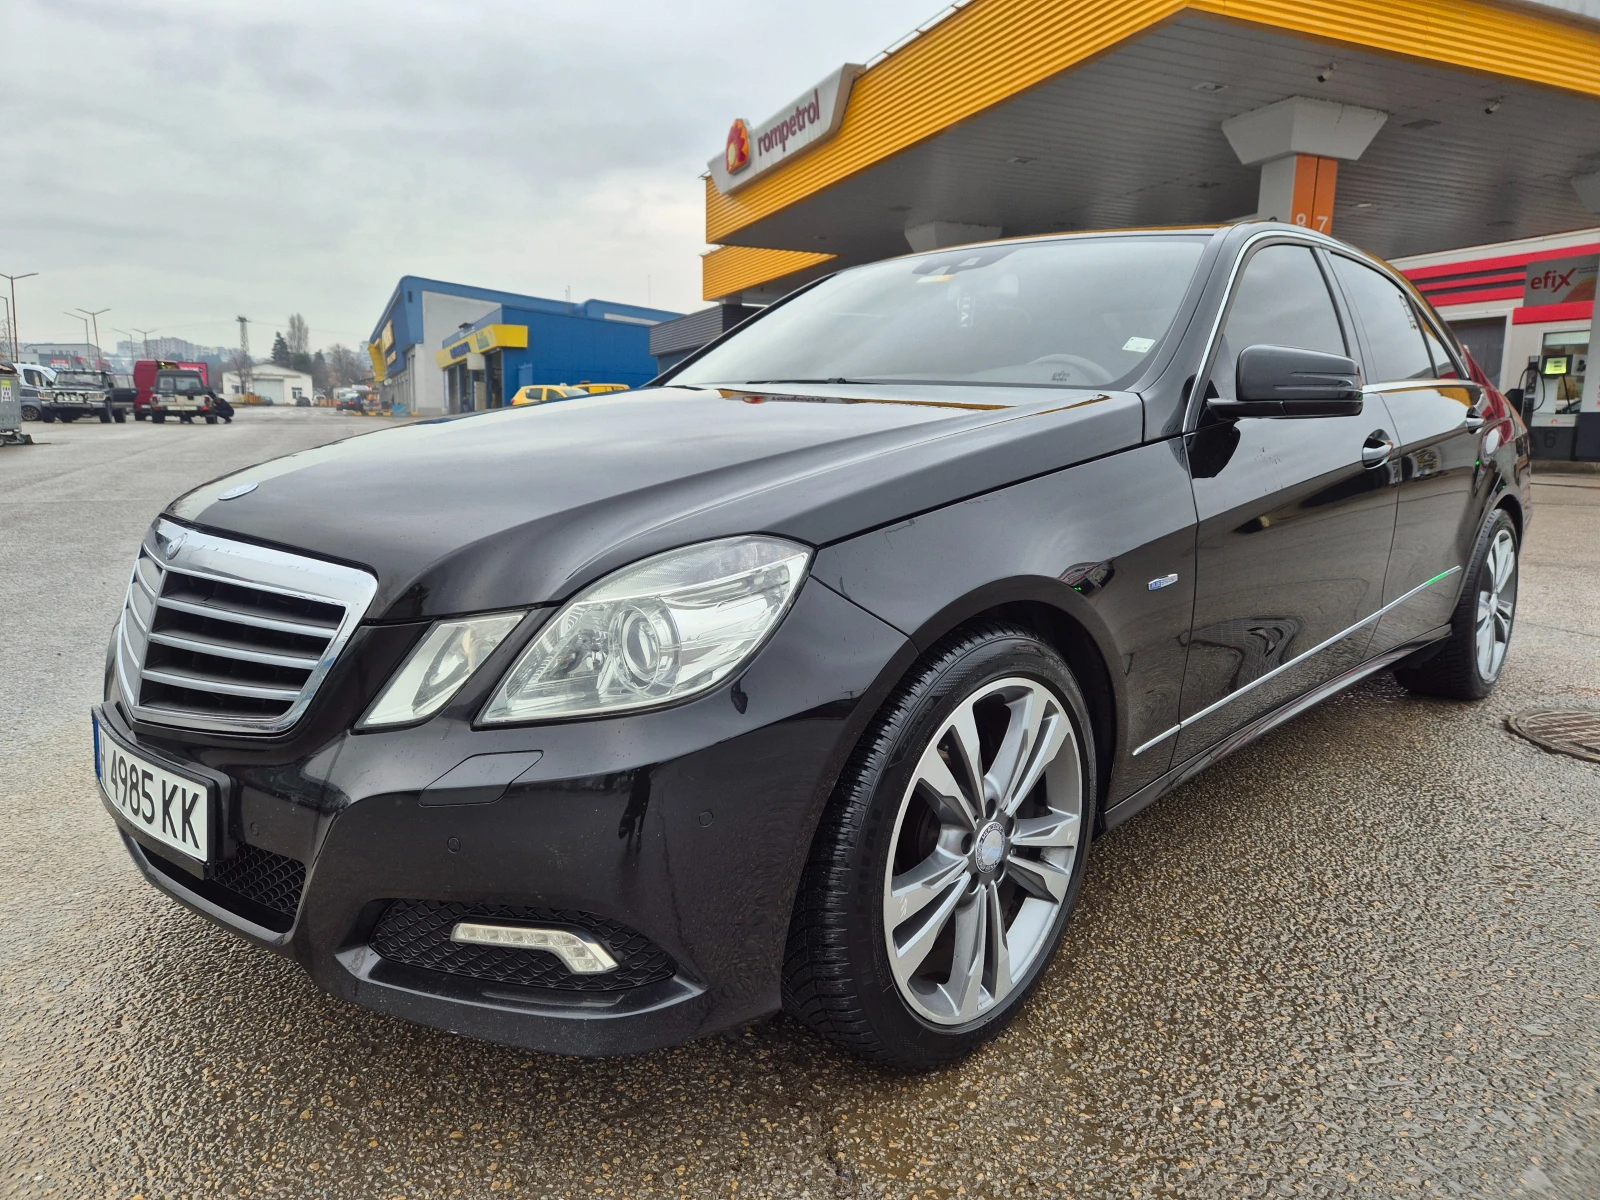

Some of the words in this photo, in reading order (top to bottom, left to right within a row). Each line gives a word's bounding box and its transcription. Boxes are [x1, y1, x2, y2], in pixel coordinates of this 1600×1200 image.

[758, 88, 820, 156] rompetrol
[1316, 215, 1329, 232] 7
[1530, 267, 1577, 293] efix
[110, 749, 155, 825] 4985
[162, 779, 200, 850] KK
